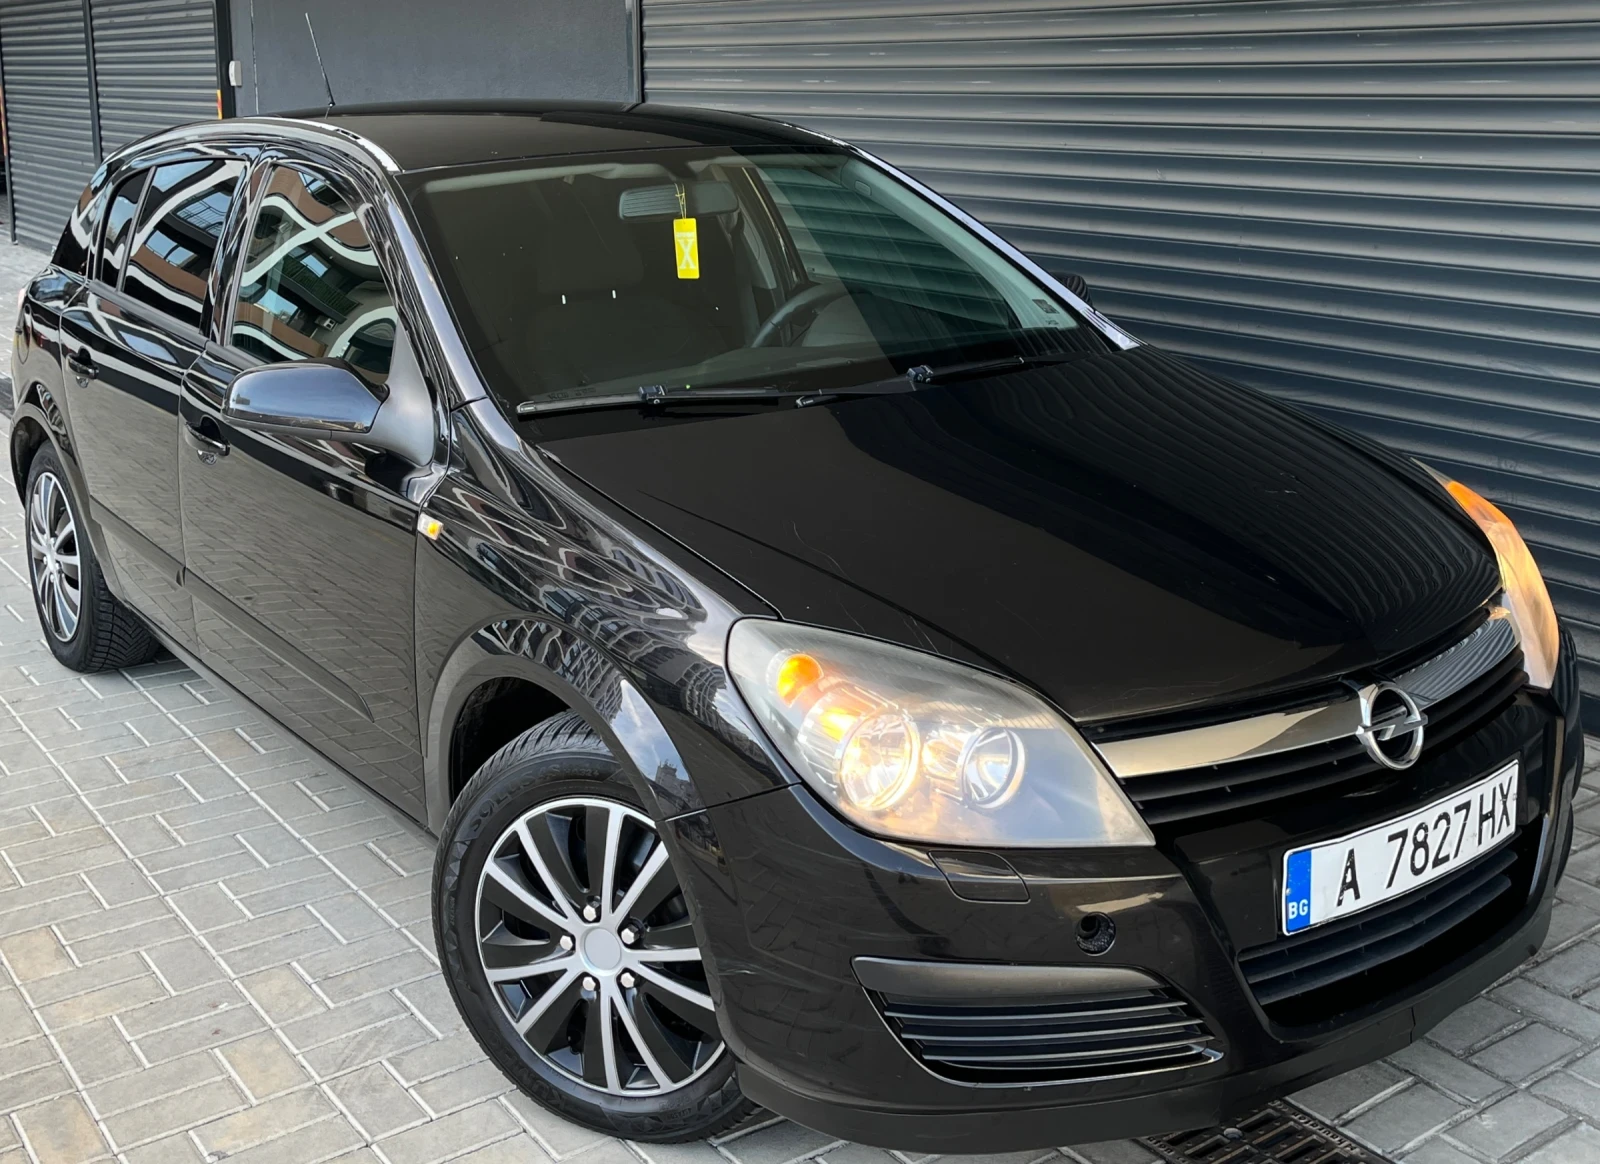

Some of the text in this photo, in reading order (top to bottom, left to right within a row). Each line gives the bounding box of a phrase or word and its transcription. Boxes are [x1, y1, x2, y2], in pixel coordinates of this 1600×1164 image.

[1336, 775, 1514, 907] A 7827 HX
[1288, 899, 1308, 919] BG
